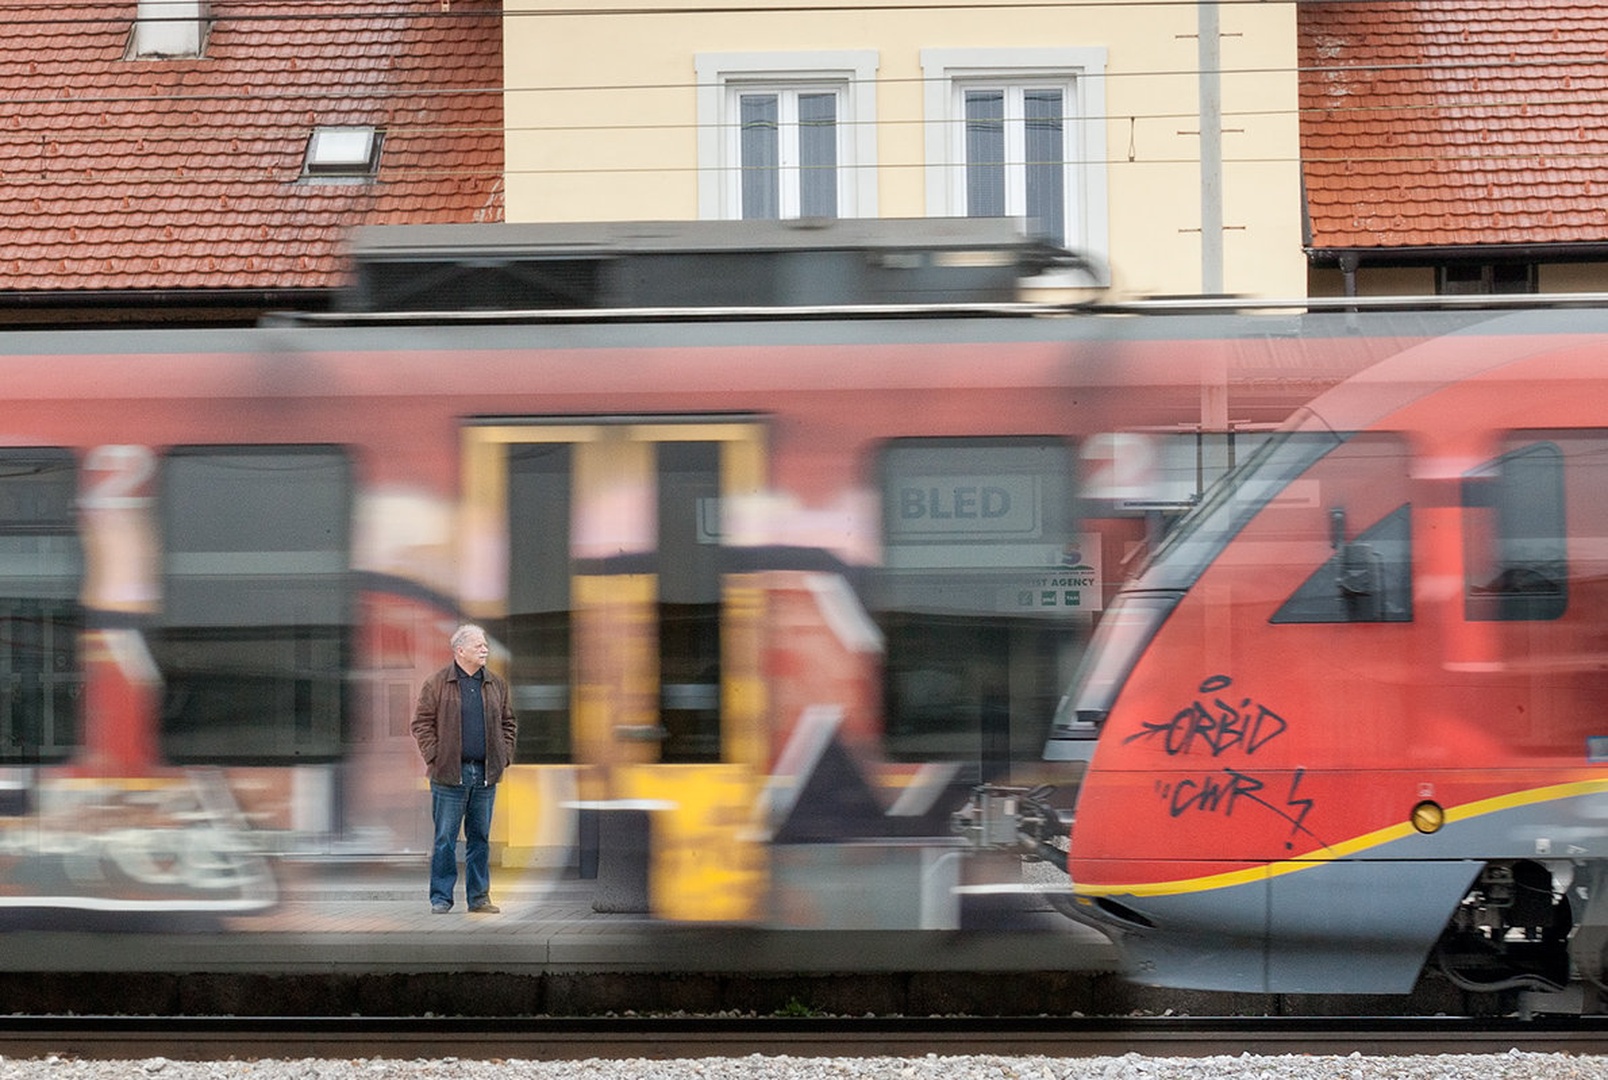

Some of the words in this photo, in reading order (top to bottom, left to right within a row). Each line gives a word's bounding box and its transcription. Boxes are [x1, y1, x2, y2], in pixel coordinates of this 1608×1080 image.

[79, 443, 159, 509] 2
[900, 486, 1011, 519] BLED
[1051, 578, 1095, 587] AGENCY
